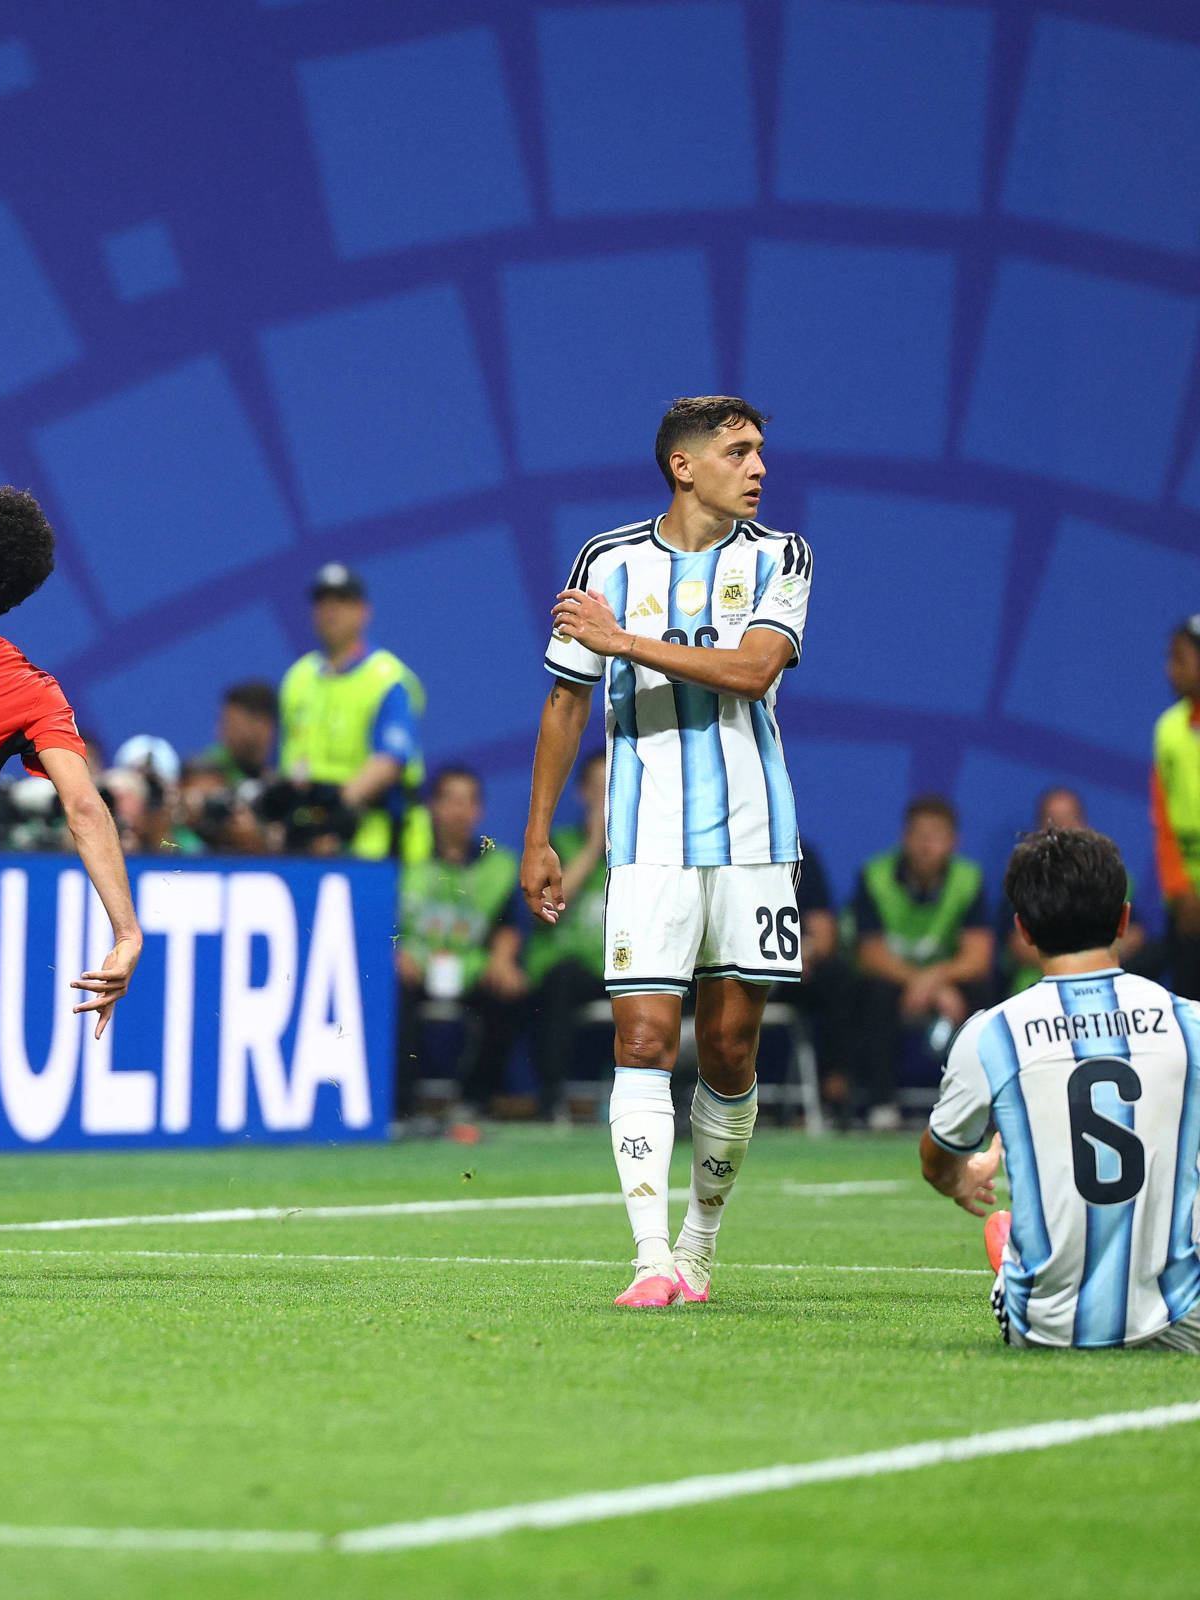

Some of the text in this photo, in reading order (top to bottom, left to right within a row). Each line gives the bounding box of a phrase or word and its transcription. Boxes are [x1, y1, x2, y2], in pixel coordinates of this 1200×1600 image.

[755, 906, 799, 961] 26
[1024, 1008, 1168, 1047] MARTINEZ
[1067, 1056, 1145, 1206] 6
